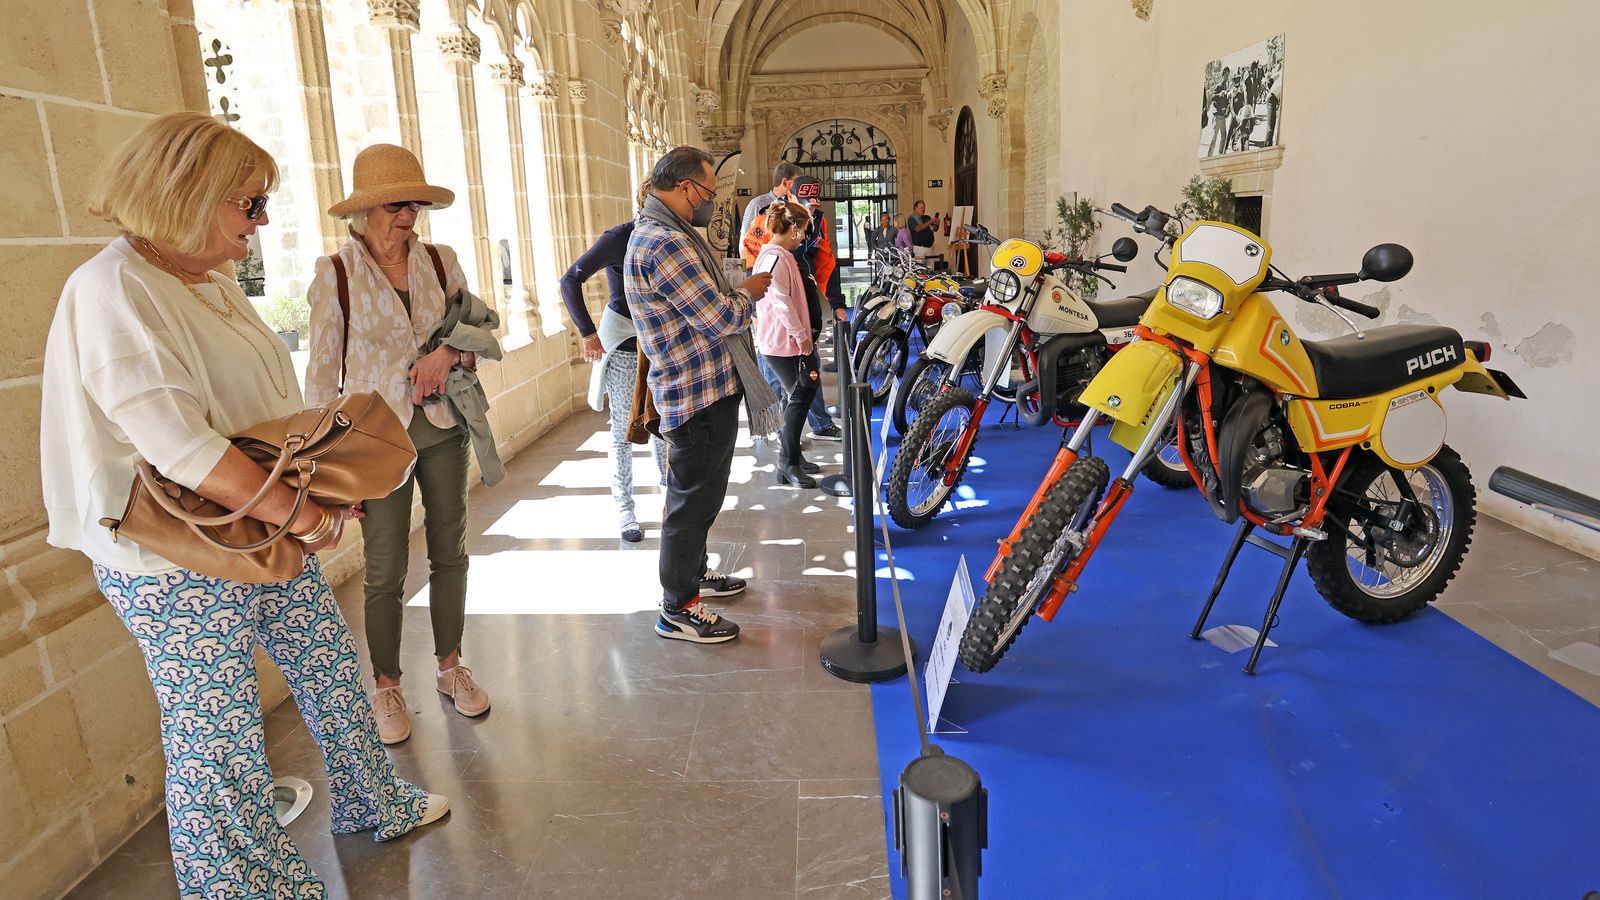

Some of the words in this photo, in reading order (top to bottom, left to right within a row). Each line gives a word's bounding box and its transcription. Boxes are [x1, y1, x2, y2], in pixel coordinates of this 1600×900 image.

[798, 183, 820, 197] 93
[1058, 305, 1089, 321] MONTESA
[1123, 330, 1134, 338] 36
[1406, 344, 1457, 376] PUCH
[1329, 401, 1361, 410] COBRA
